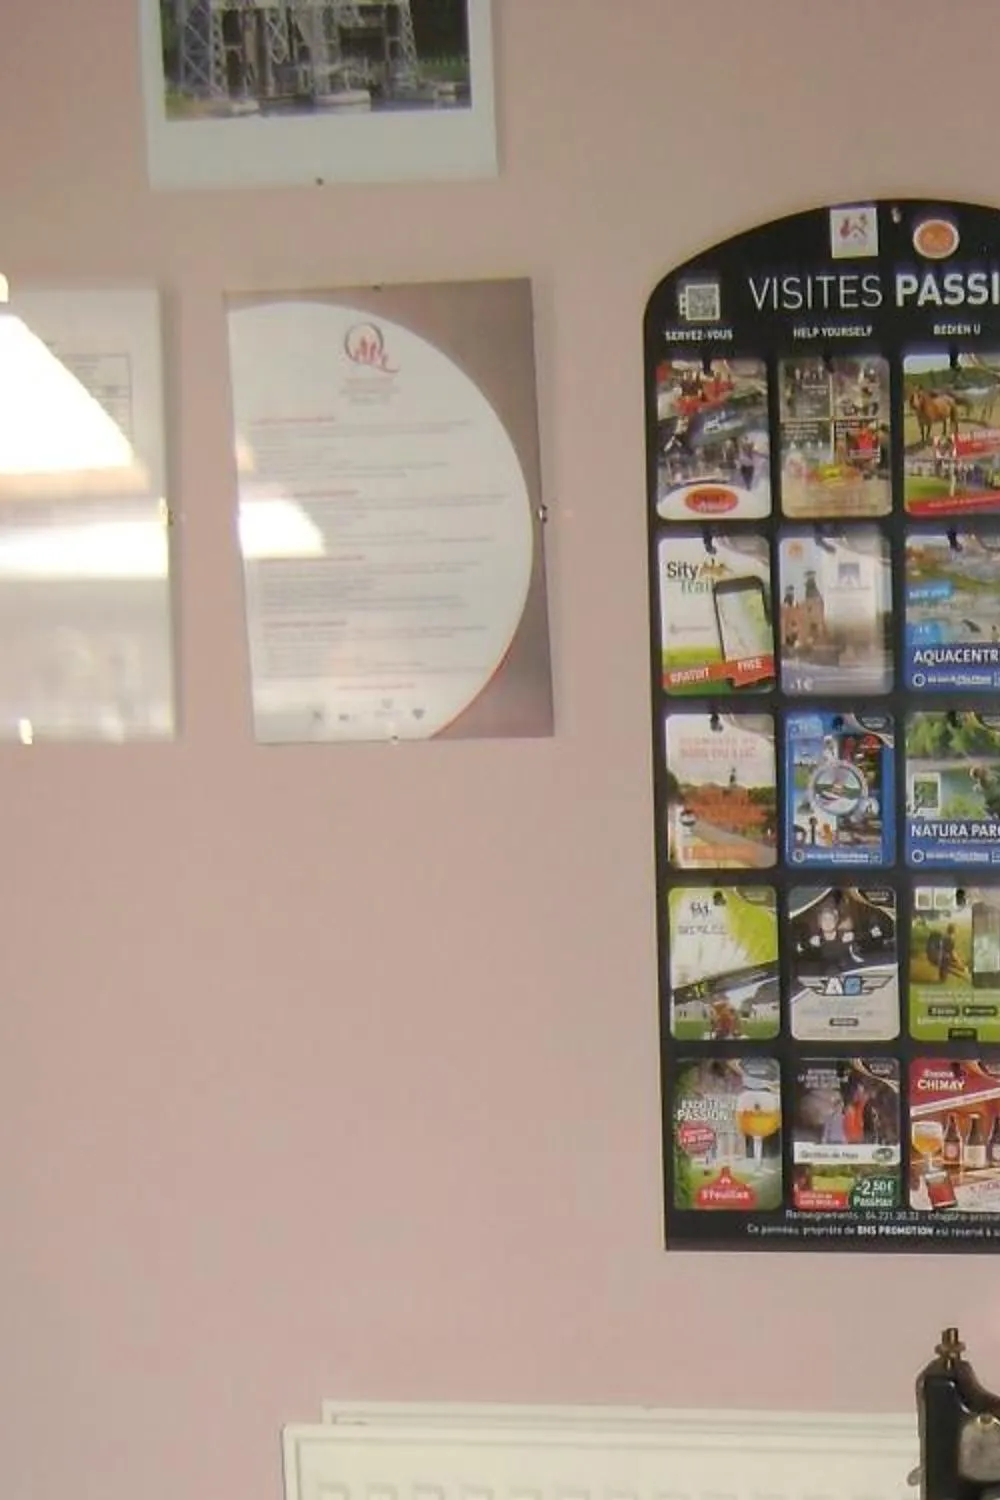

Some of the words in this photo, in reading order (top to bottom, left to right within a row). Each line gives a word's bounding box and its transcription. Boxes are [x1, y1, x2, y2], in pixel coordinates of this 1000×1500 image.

[748, 275, 883, 311] VISITES
[665, 328, 734, 342] SERVEZ-VOUS
[793, 326, 819, 339] HELP
[822, 325, 873, 338] YOURSELF
[973, 322, 981, 335] U
[667, 560, 699, 580] Sity
[911, 823, 968, 838] NATURA
[917, 1079, 966, 1092] CHIMAY
[878, 1225, 933, 1237] PROMOTION
